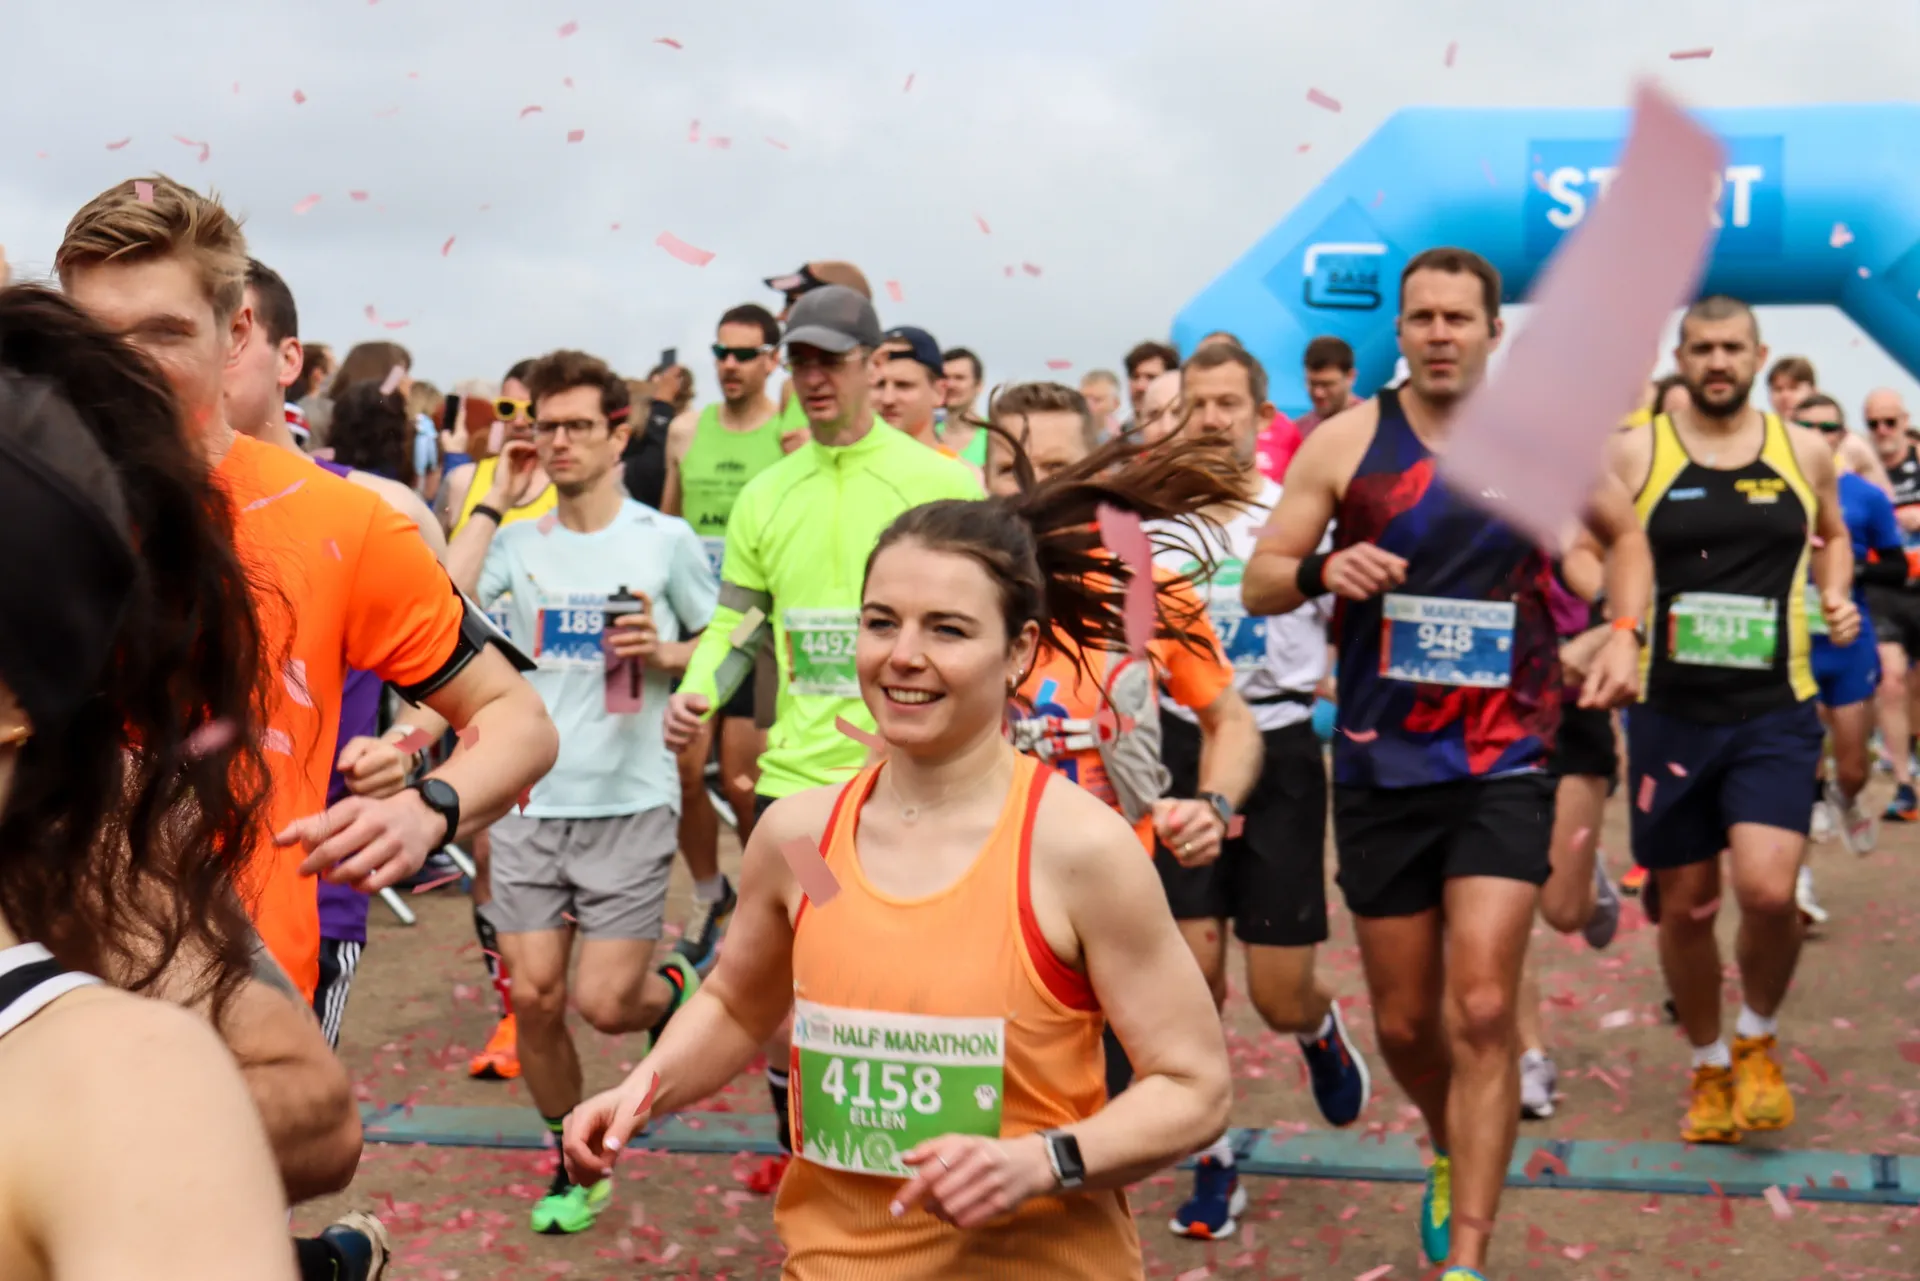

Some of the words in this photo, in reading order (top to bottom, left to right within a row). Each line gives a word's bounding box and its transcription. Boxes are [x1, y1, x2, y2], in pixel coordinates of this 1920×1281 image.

[1546, 165, 1765, 230] STT
[1421, 603, 1510, 623] MARATHON
[801, 631, 857, 655] 4492
[1418, 623, 1474, 653] 948
[832, 1024, 880, 1048] HALF
[884, 1028, 998, 1057] MARATHON
[821, 1057, 942, 1115] 4158
[850, 1106, 907, 1131] ELLEN
